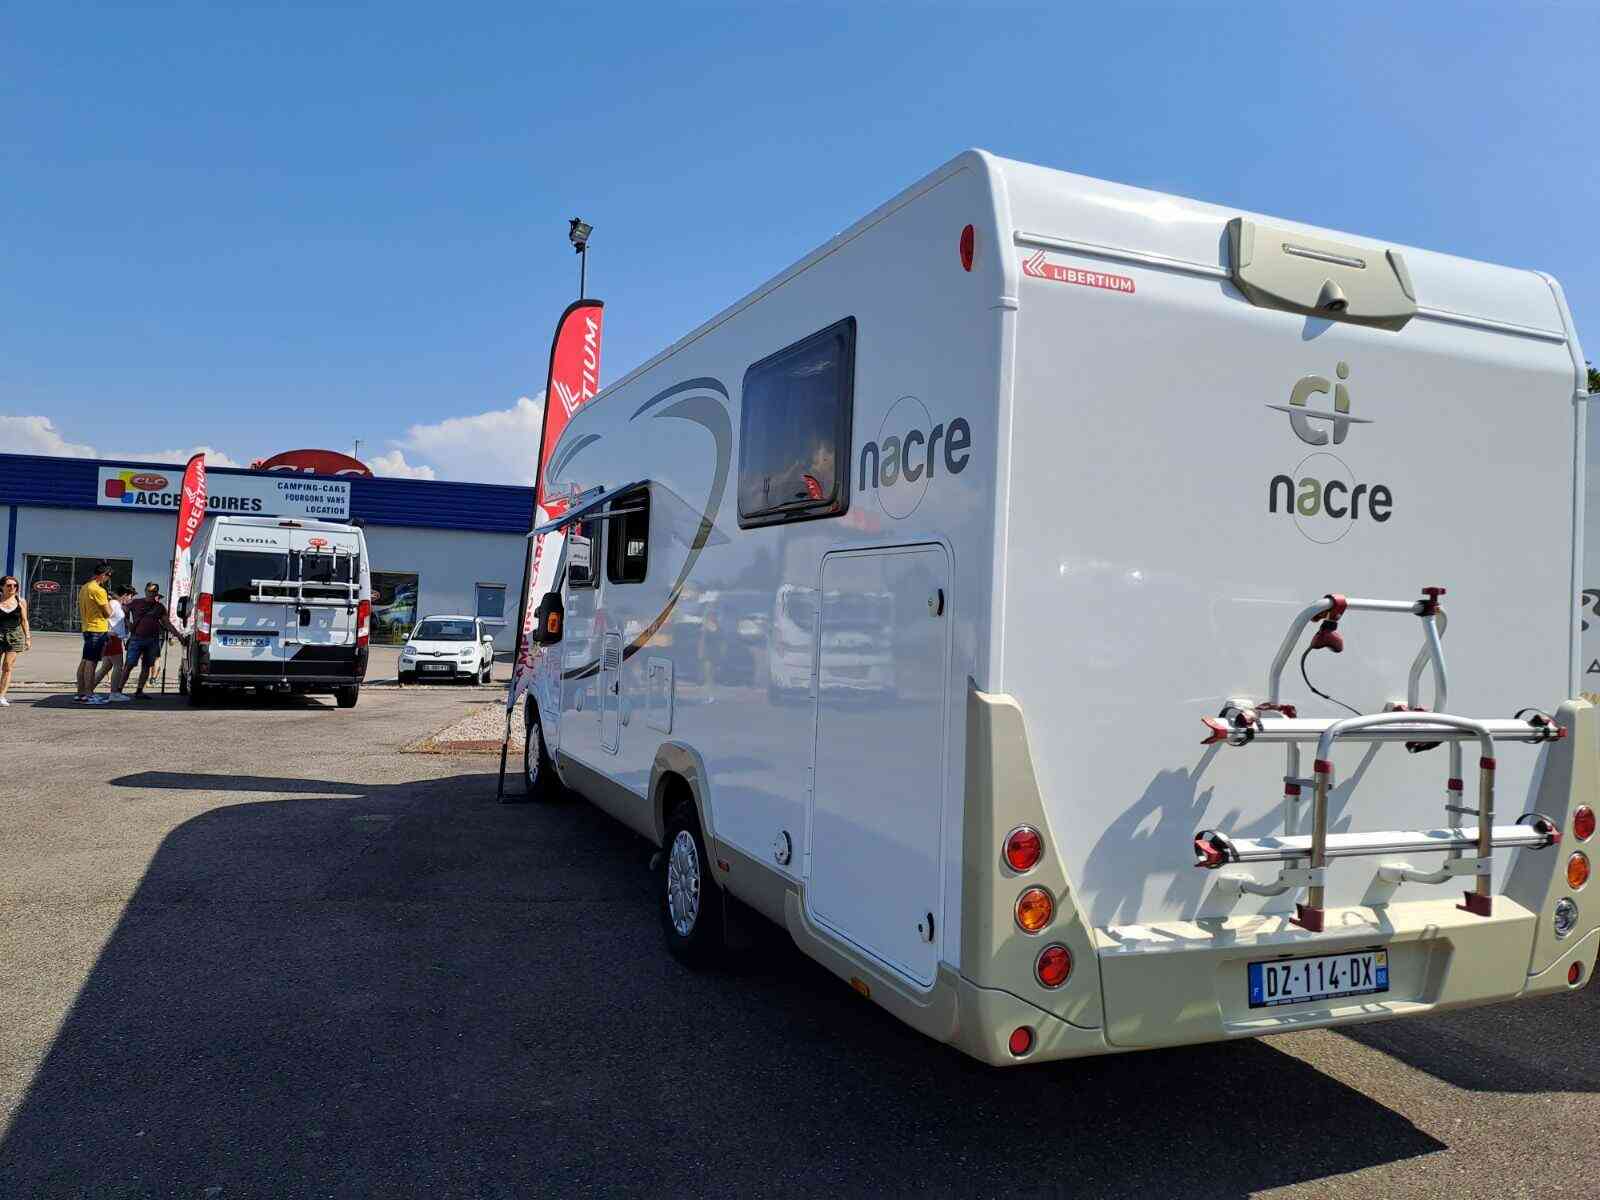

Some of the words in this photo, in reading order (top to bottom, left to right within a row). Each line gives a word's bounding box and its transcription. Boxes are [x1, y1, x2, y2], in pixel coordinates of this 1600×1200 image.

[1054, 267, 1132, 291] LIBERTIUM
[859, 417, 971, 492] nacre
[277, 482, 346, 493] CAMPING-CARS
[285, 493, 324, 503] FOURGONS
[326, 496, 345, 504] VANS
[1269, 474, 1393, 522] nacre
[135, 492, 262, 512] ACCEOIRES
[184, 461, 206, 544] LIBERTIUM
[305, 505, 345, 515] LOCATION
